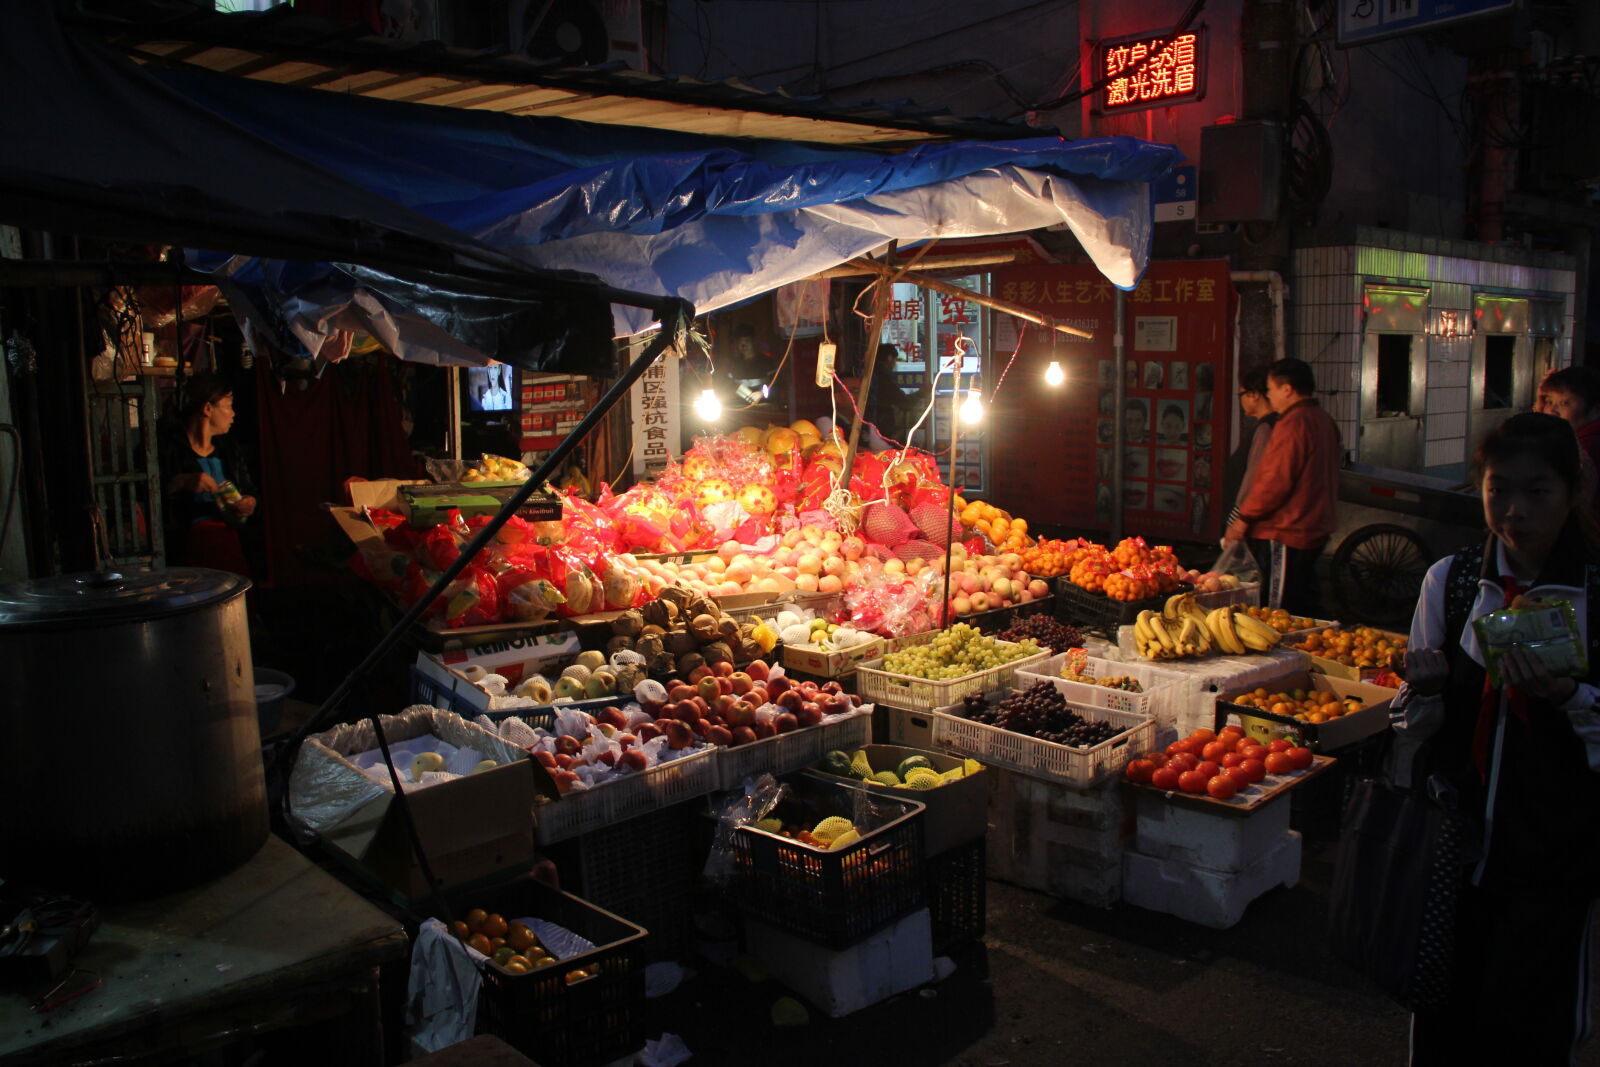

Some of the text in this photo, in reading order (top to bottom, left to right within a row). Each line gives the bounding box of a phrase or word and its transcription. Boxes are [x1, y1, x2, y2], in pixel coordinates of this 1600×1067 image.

[1107, 64, 1195, 105] 激光洗眉
[1177, 205, 1185, 216] S
[1002, 278, 1216, 303] 多彩人生艺术绣工作室
